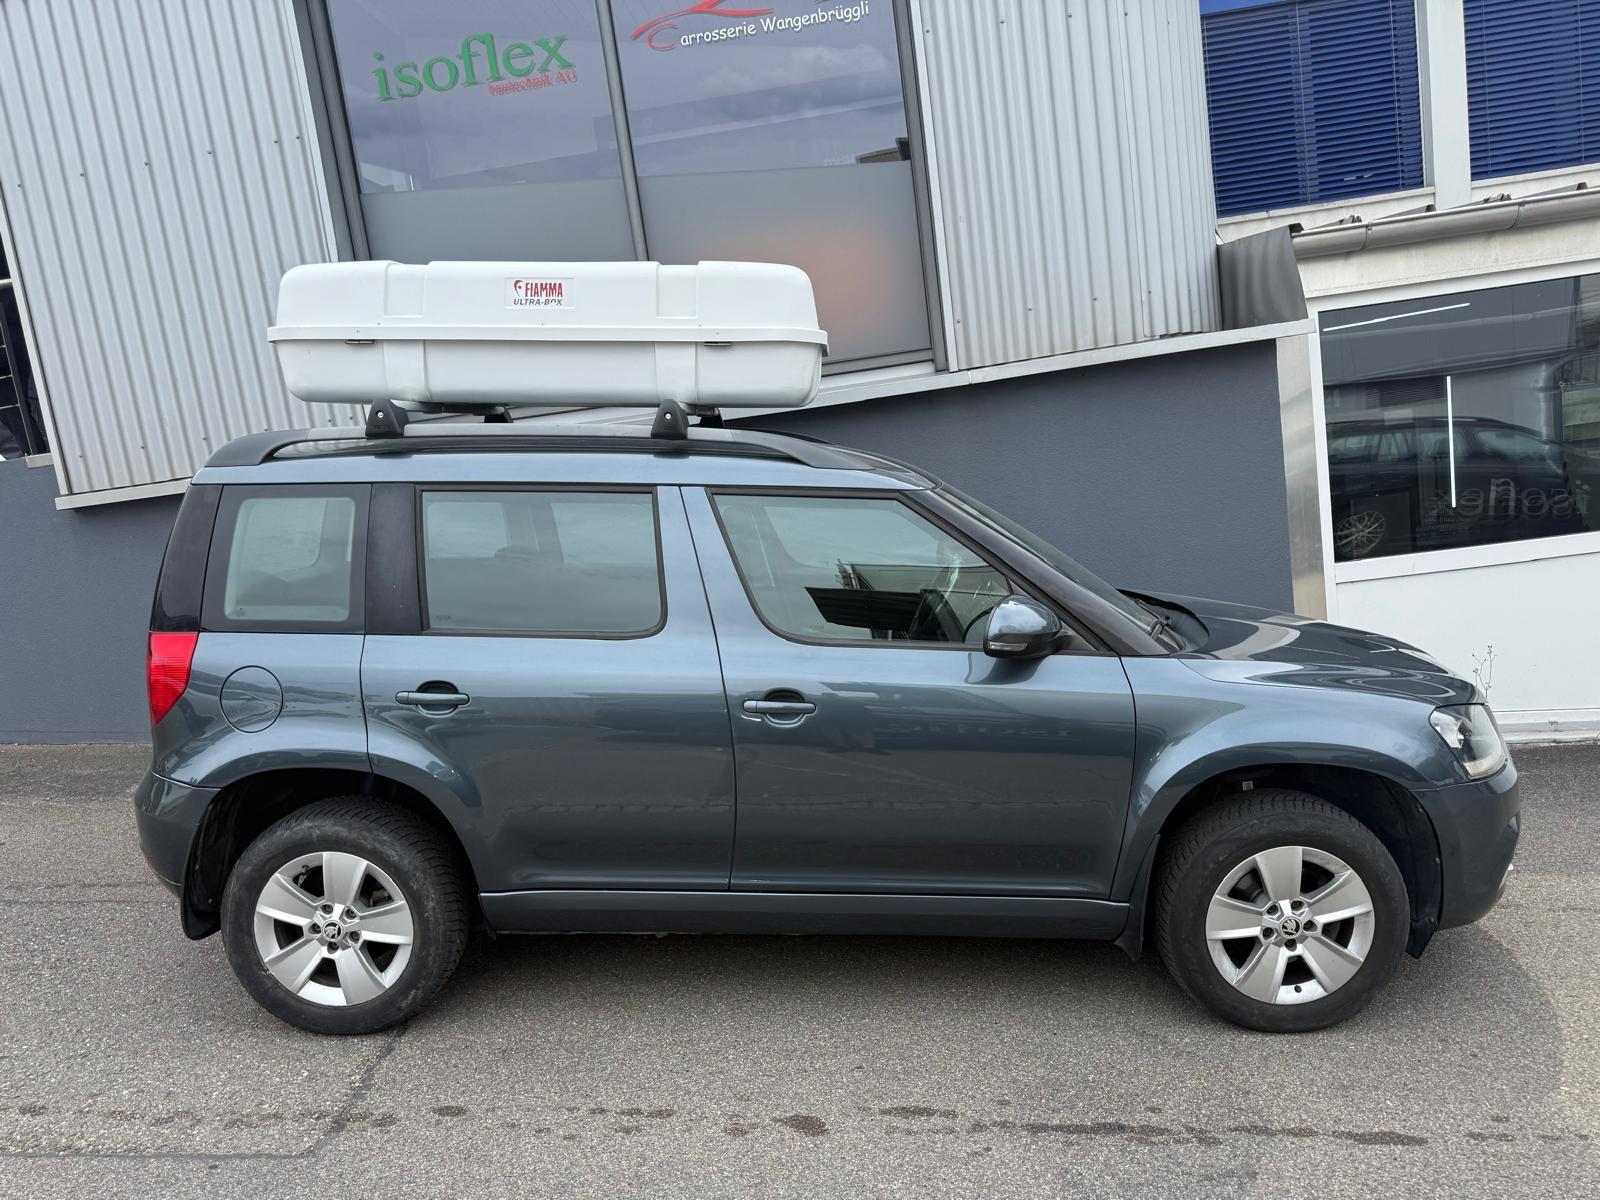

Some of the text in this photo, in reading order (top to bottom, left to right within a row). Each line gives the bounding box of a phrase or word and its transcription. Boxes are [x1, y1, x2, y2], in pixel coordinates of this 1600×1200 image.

[646, 1, 871, 51] Carrosserie Wangenbrüggli
[371, 31, 577, 101] isoflex
[555, 67, 578, 85] AG
[524, 282, 564, 298] FIAMMA
